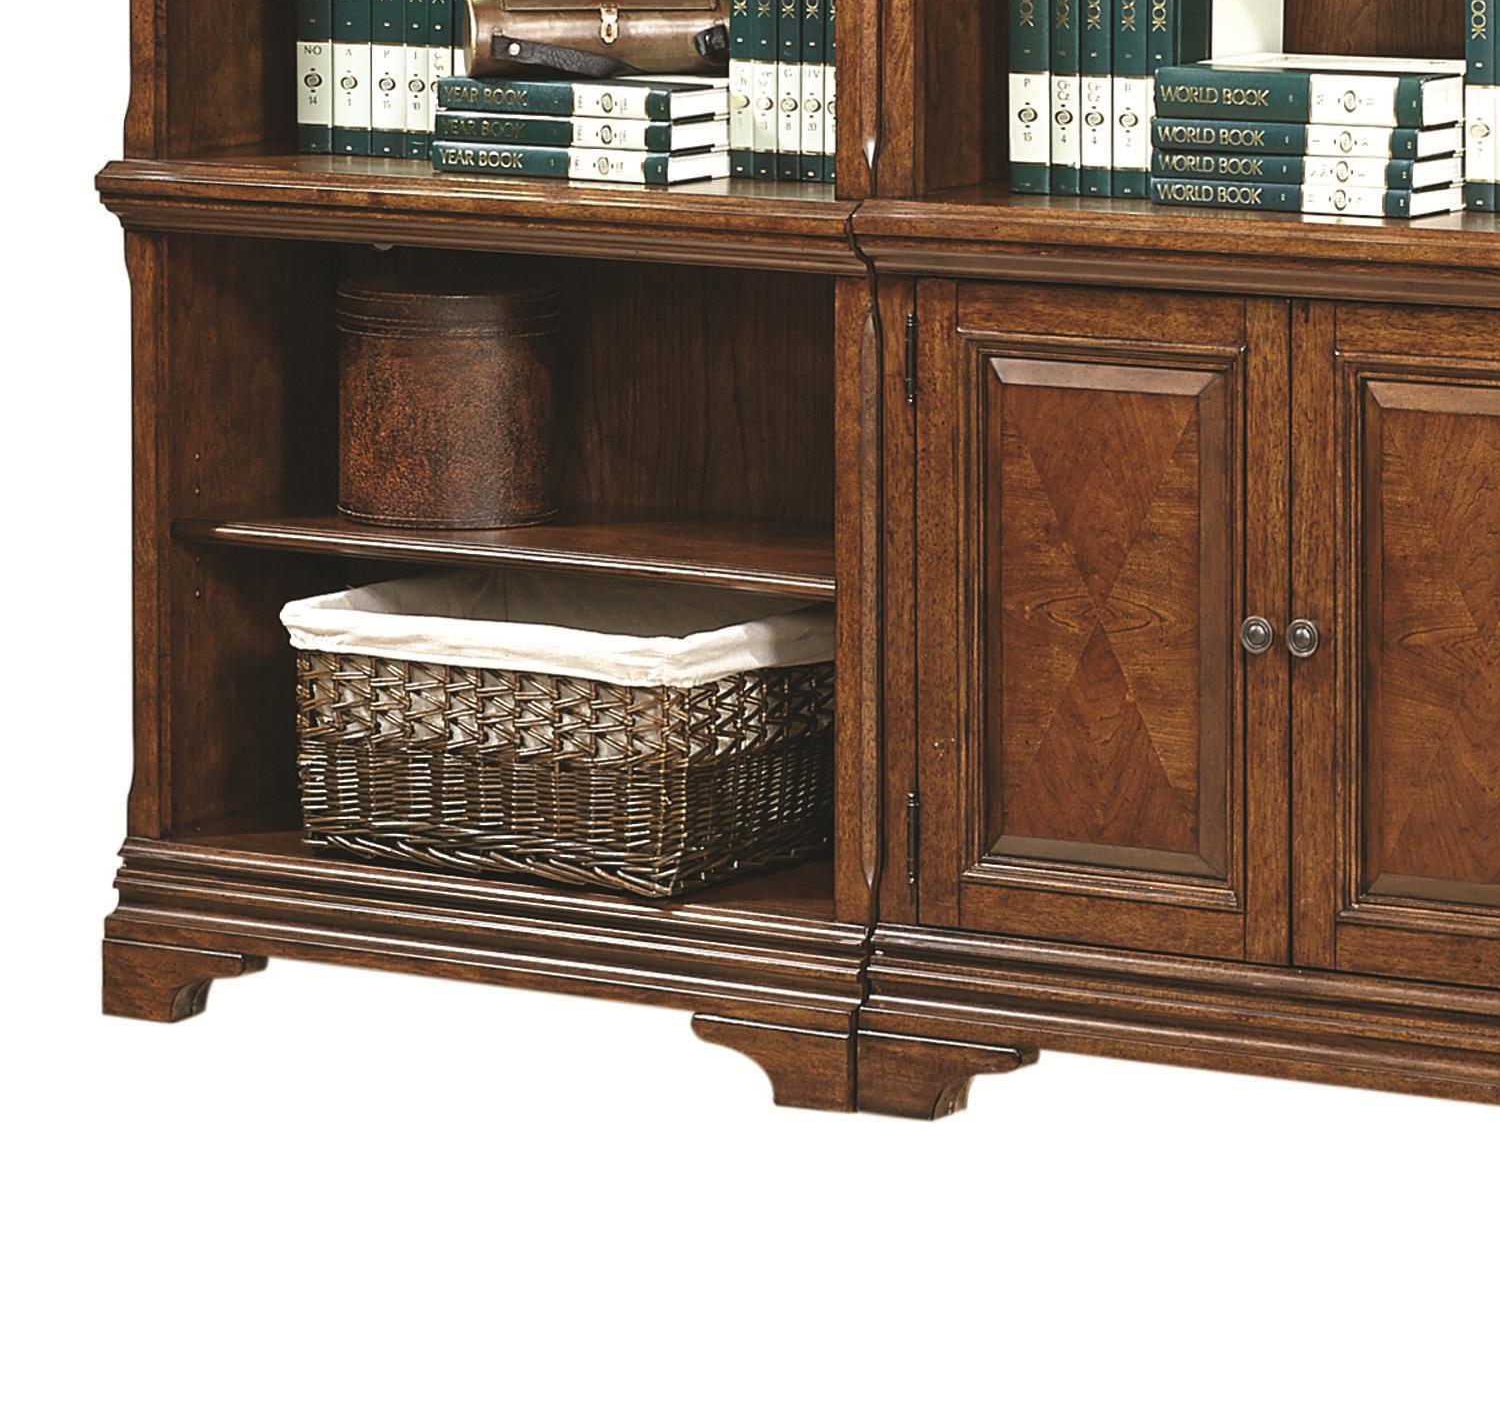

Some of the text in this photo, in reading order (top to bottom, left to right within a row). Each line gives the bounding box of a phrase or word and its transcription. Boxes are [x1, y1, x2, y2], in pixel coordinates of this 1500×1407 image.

[1023, 78, 1031, 88] P
[309, 96, 318, 105] 14
[445, 87, 527, 107] YEAR BOOK
[1160, 84, 1270, 107] WORLD BOOK
[441, 118, 525, 139] YEAR BOOK
[1023, 132, 1033, 142] 15
[1158, 126, 1266, 147] WORLD BOOK
[439, 149, 524, 169] YEAR BOOK
[1158, 154, 1264, 176] WORLD BOOK
[1156, 183, 1263, 205] WORLD BOOK
